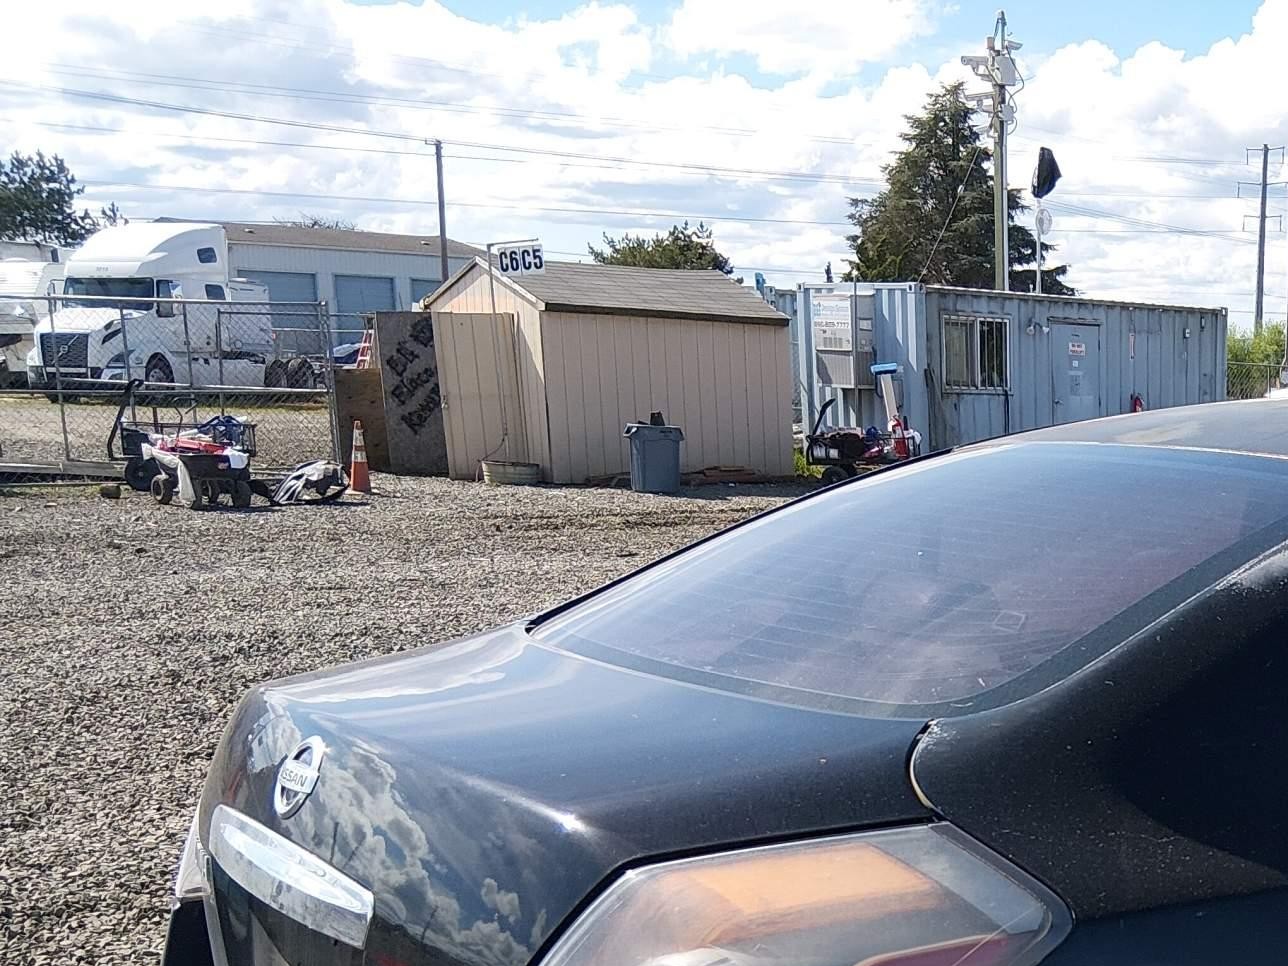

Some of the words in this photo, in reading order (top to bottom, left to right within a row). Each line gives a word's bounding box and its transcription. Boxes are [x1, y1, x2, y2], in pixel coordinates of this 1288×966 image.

[499, 250, 520, 272] C6
[521, 248, 544, 270] C5
[279, 767, 308, 788] ISSAN
